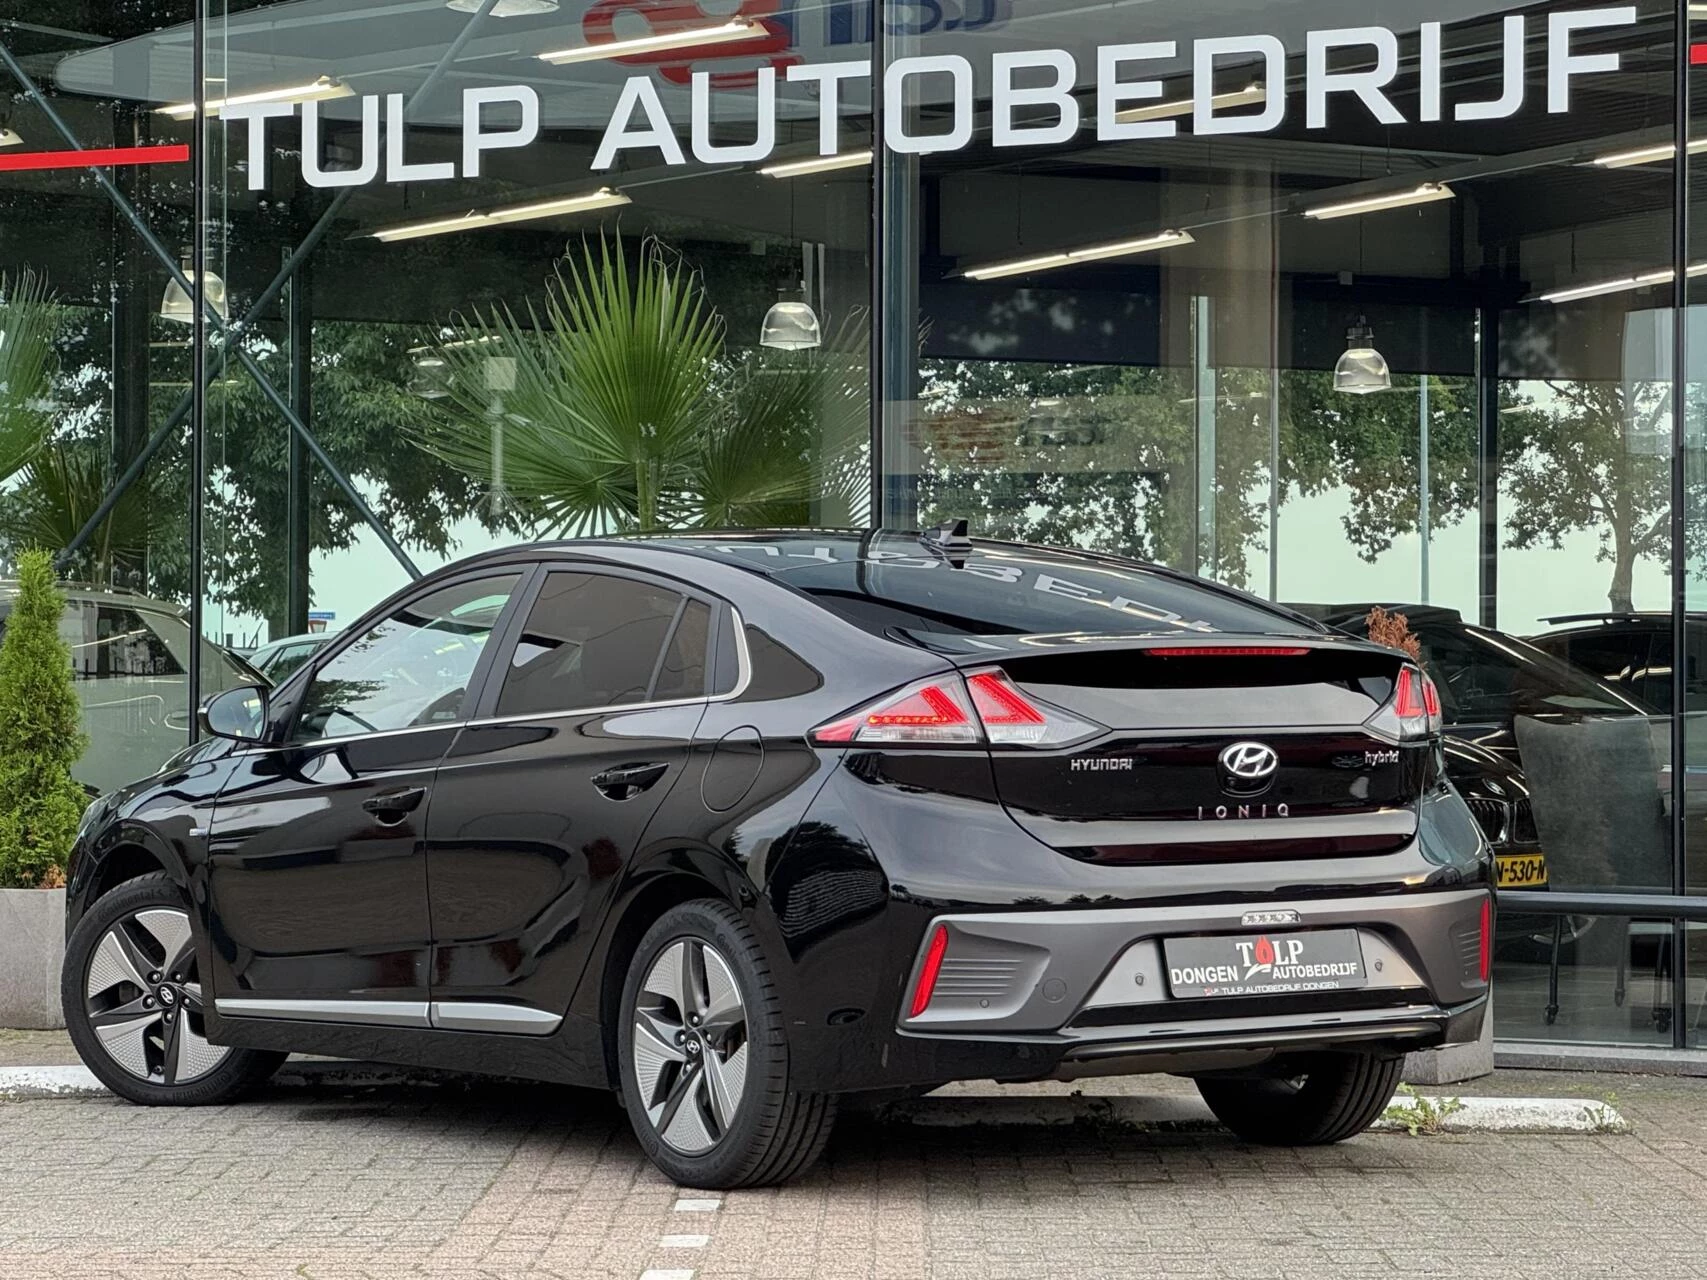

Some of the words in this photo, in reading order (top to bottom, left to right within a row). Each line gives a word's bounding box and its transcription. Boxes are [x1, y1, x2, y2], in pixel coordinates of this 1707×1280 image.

[219, 85, 538, 191] TULP
[591, 6, 1637, 171] AUTOBEDRIJF
[1071, 757, 1134, 771] HYUNDAI
[1364, 750, 1400, 766] hybrid
[1198, 803, 1290, 820] IONIQ
[1170, 965, 1239, 985] DONGEN
[1272, 963, 1358, 979] AUTOBEDRIJF
[1221, 986, 1244, 995] TULP
[1245, 983, 1301, 994] AUTOBEDRIJF
[1303, 981, 1339, 991] DONGEN
